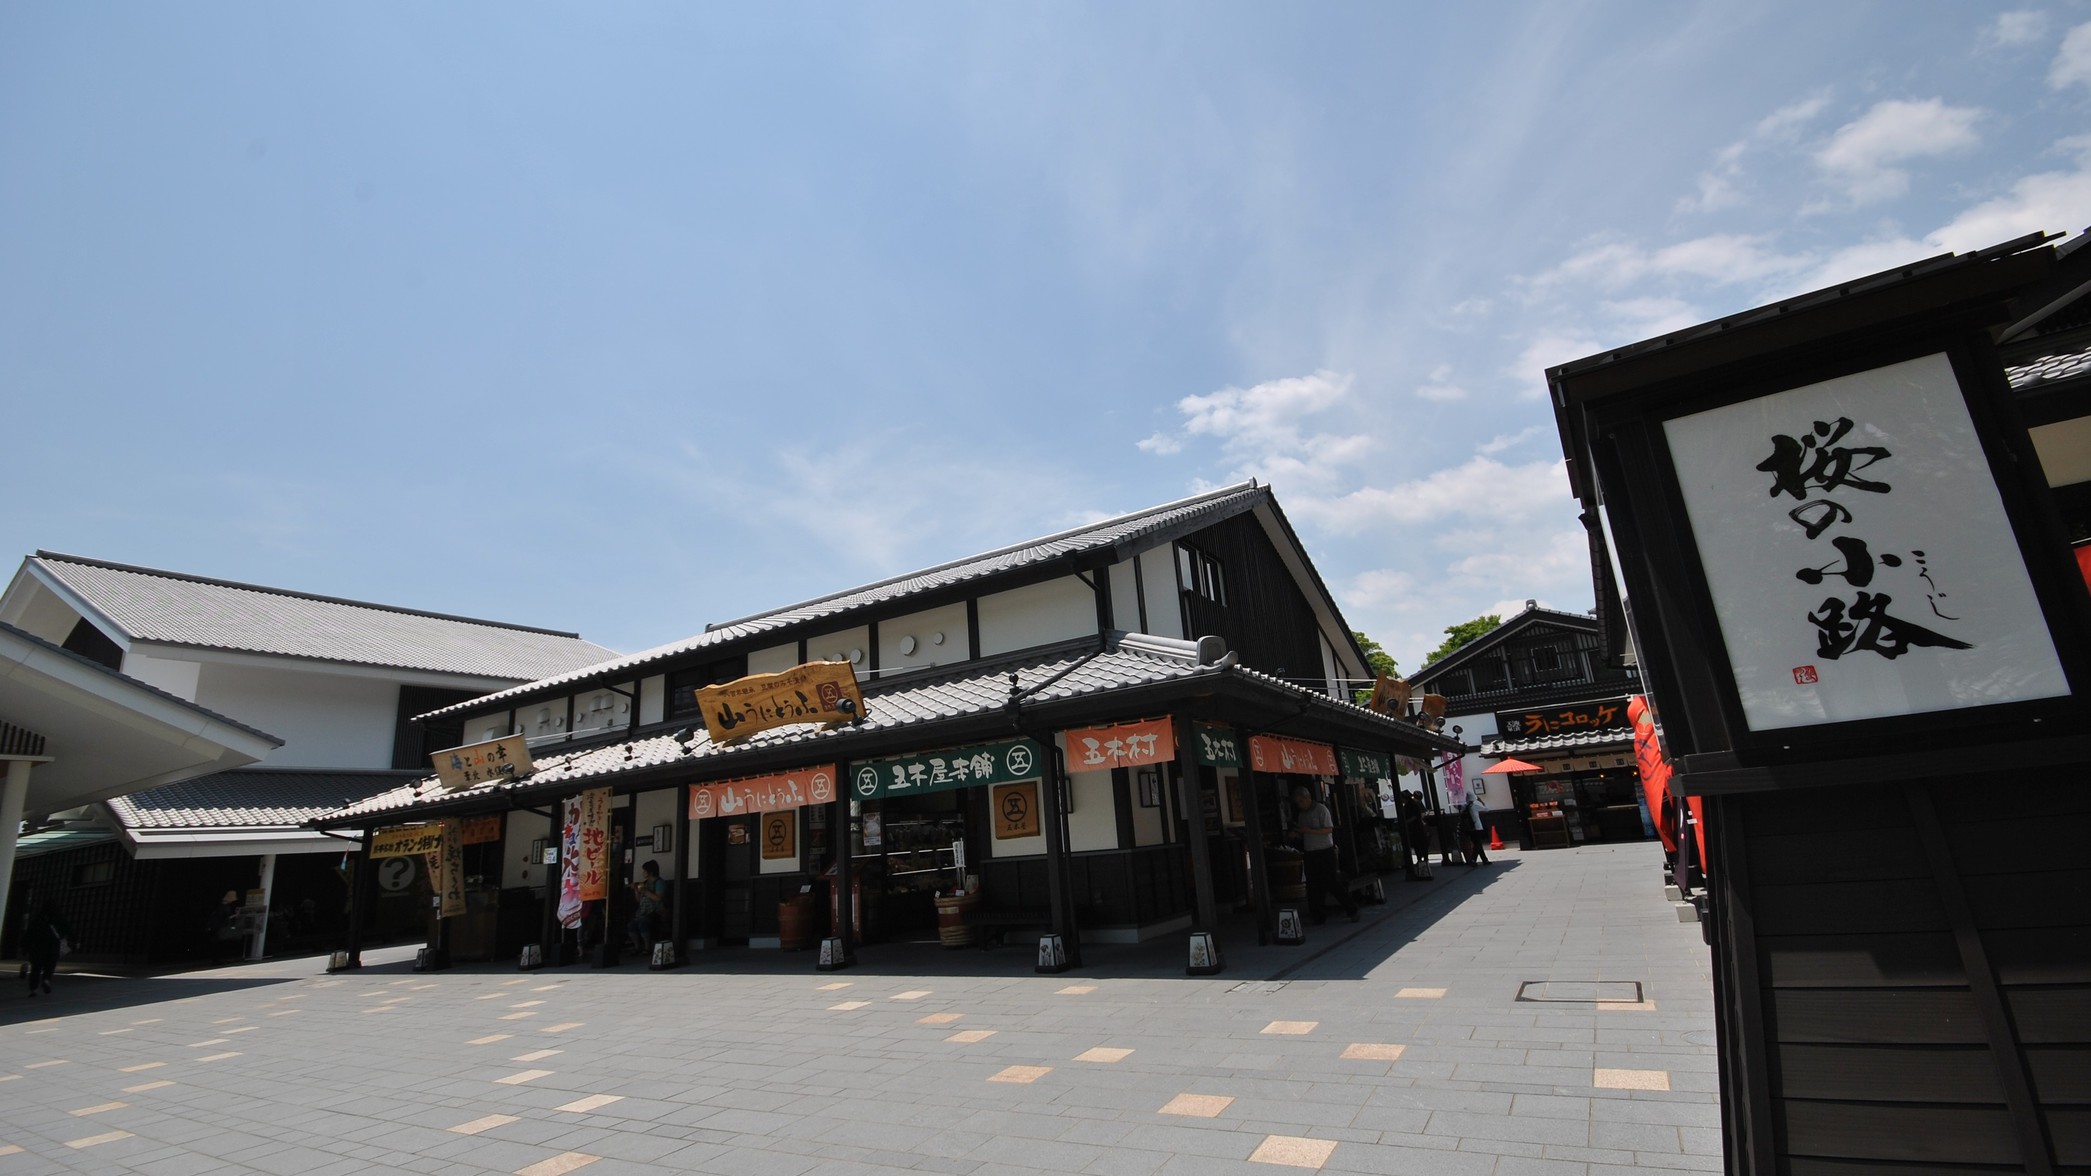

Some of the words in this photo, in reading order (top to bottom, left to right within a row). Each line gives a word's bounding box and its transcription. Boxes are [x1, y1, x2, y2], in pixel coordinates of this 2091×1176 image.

[1756, 417, 1976, 660] 桜の小路
[1911, 550, 1960, 620] こうじ
[717, 690, 818, 730] 山うにとうふ
[450, 743, 507, 770] 海と山の幸
[1082, 732, 1157, 765] 五木村
[888, 752, 995, 790] 五木屋本舗
[721, 779, 804, 813] 山うにとうふ
[583, 828, 605, 885] 地ビール
